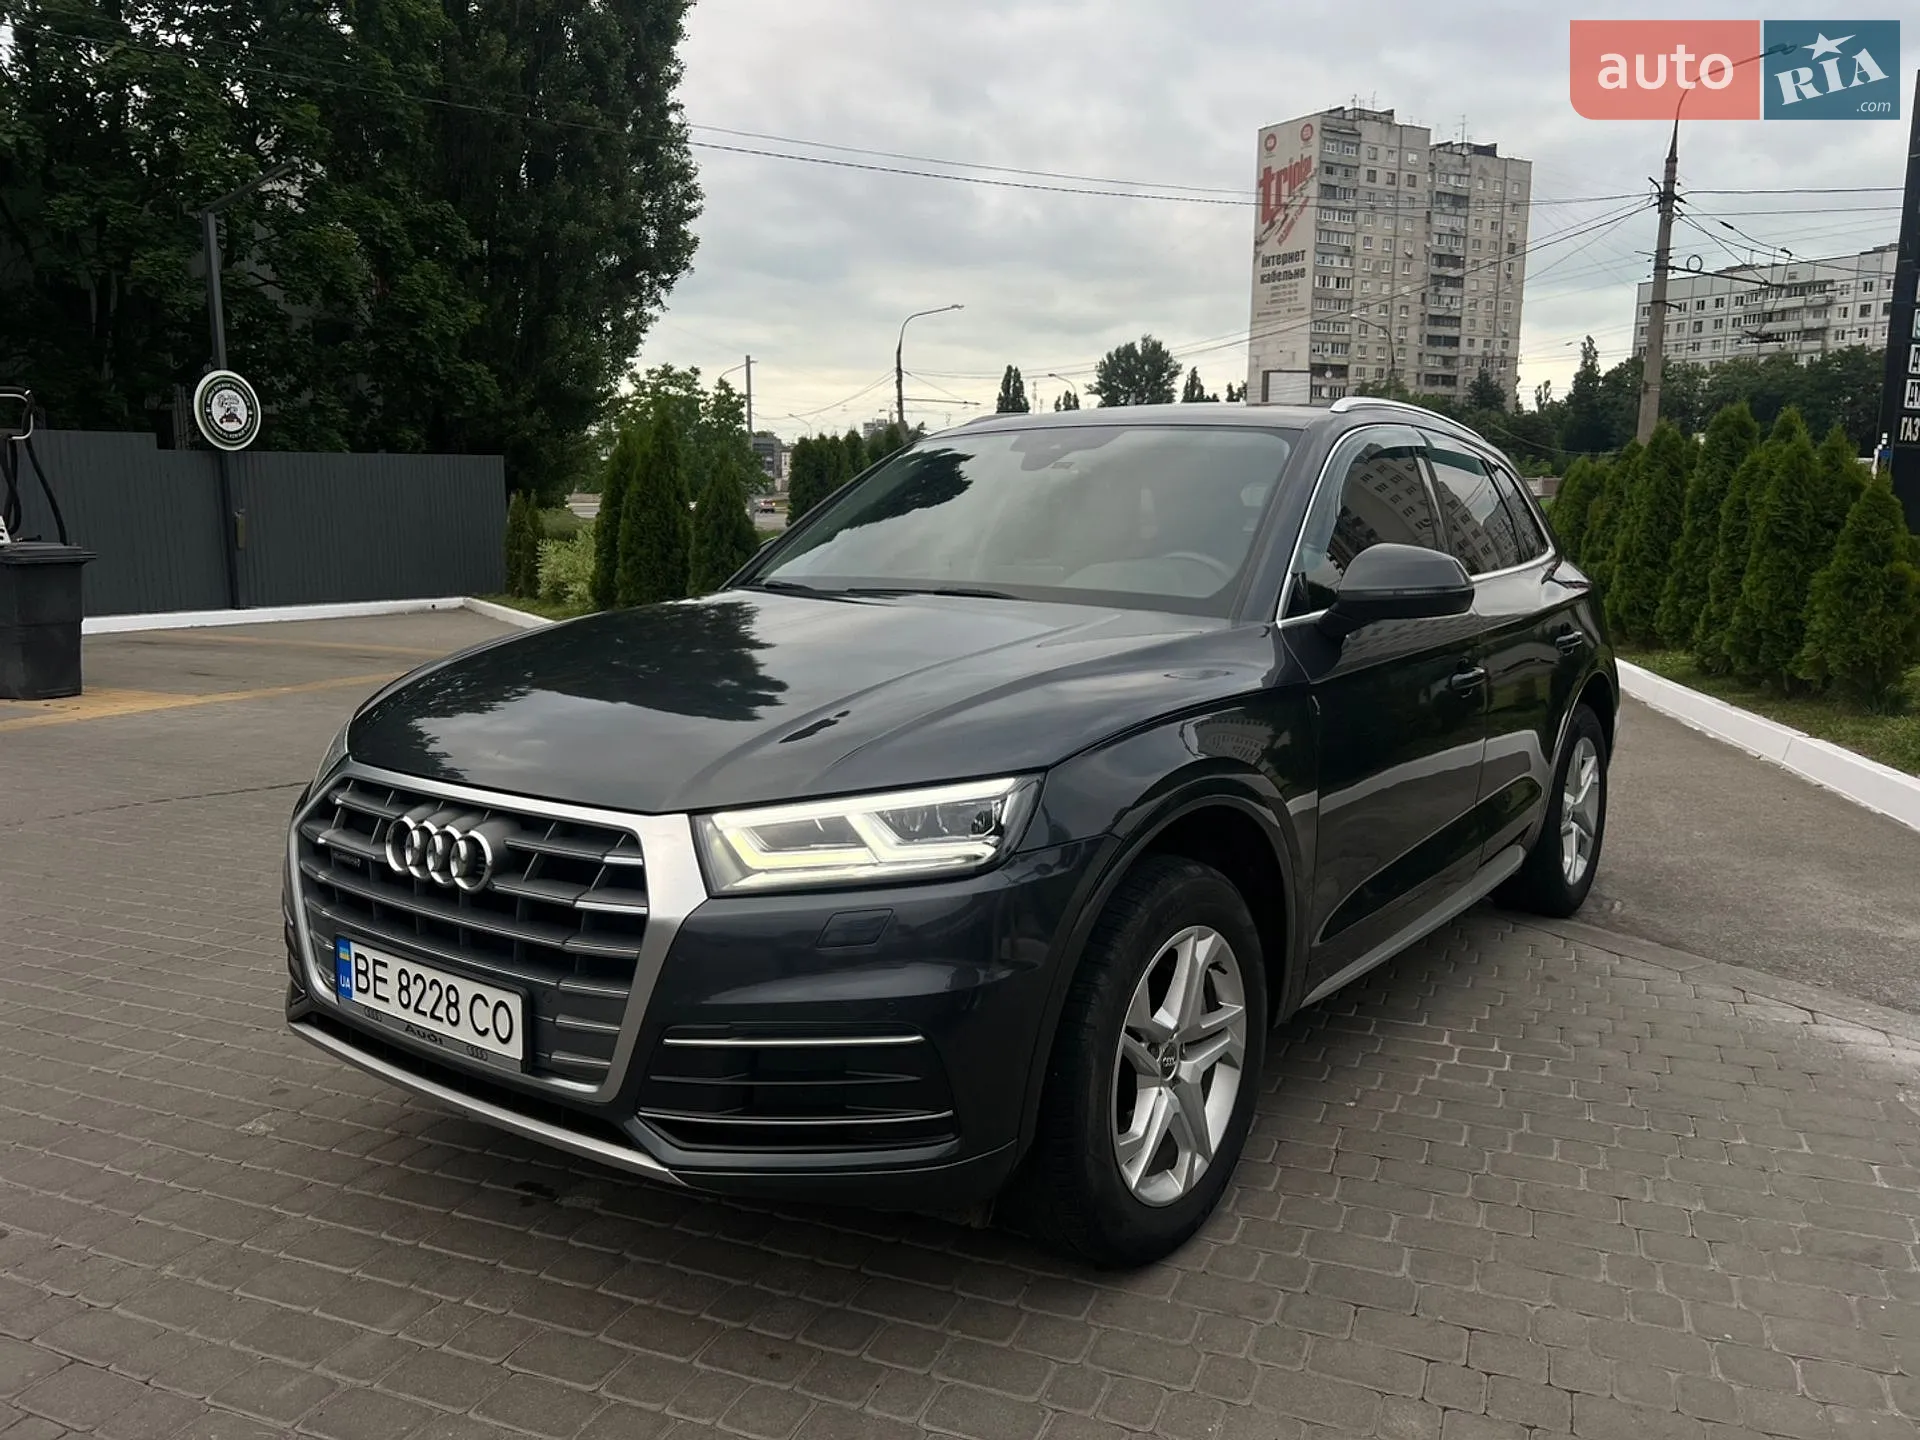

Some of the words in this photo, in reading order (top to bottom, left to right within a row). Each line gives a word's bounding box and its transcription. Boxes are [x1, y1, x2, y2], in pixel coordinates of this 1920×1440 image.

[1261, 249, 1306, 268] інтернет
[340, 975, 351, 989] UA
[354, 951, 390, 1003] BE
[398, 968, 460, 1027] 8228
[469, 993, 513, 1045] CO
